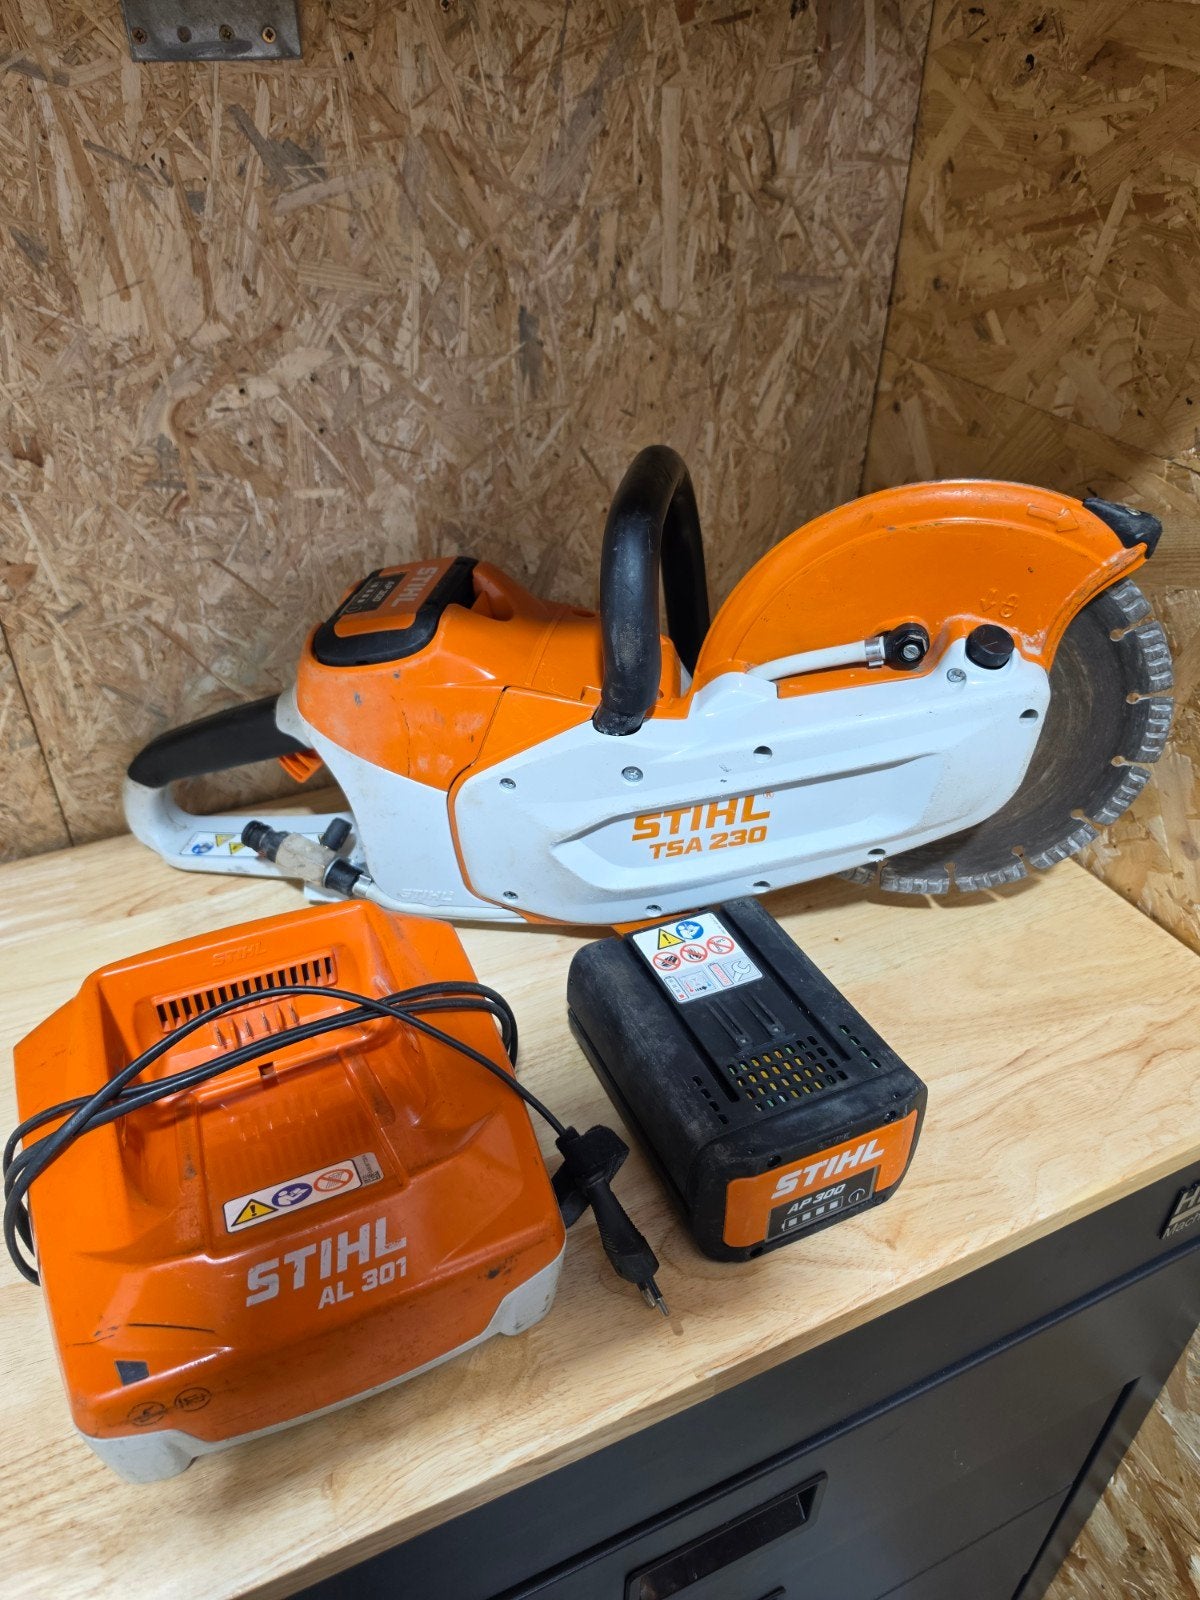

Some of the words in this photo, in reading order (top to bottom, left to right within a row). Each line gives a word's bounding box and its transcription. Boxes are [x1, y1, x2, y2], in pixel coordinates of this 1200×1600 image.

[391, 567, 438, 608] STIHL
[649, 836, 703, 860] TSA
[709, 826, 768, 851] 230
[212, 940, 268, 967] STIHL
[771, 1138, 885, 1200] STIHL
[787, 1198, 812, 1215] AP
[246, 1217, 407, 1308] STIHL
[317, 1281, 354, 1310] AL
[362, 1256, 407, 1292] 301
